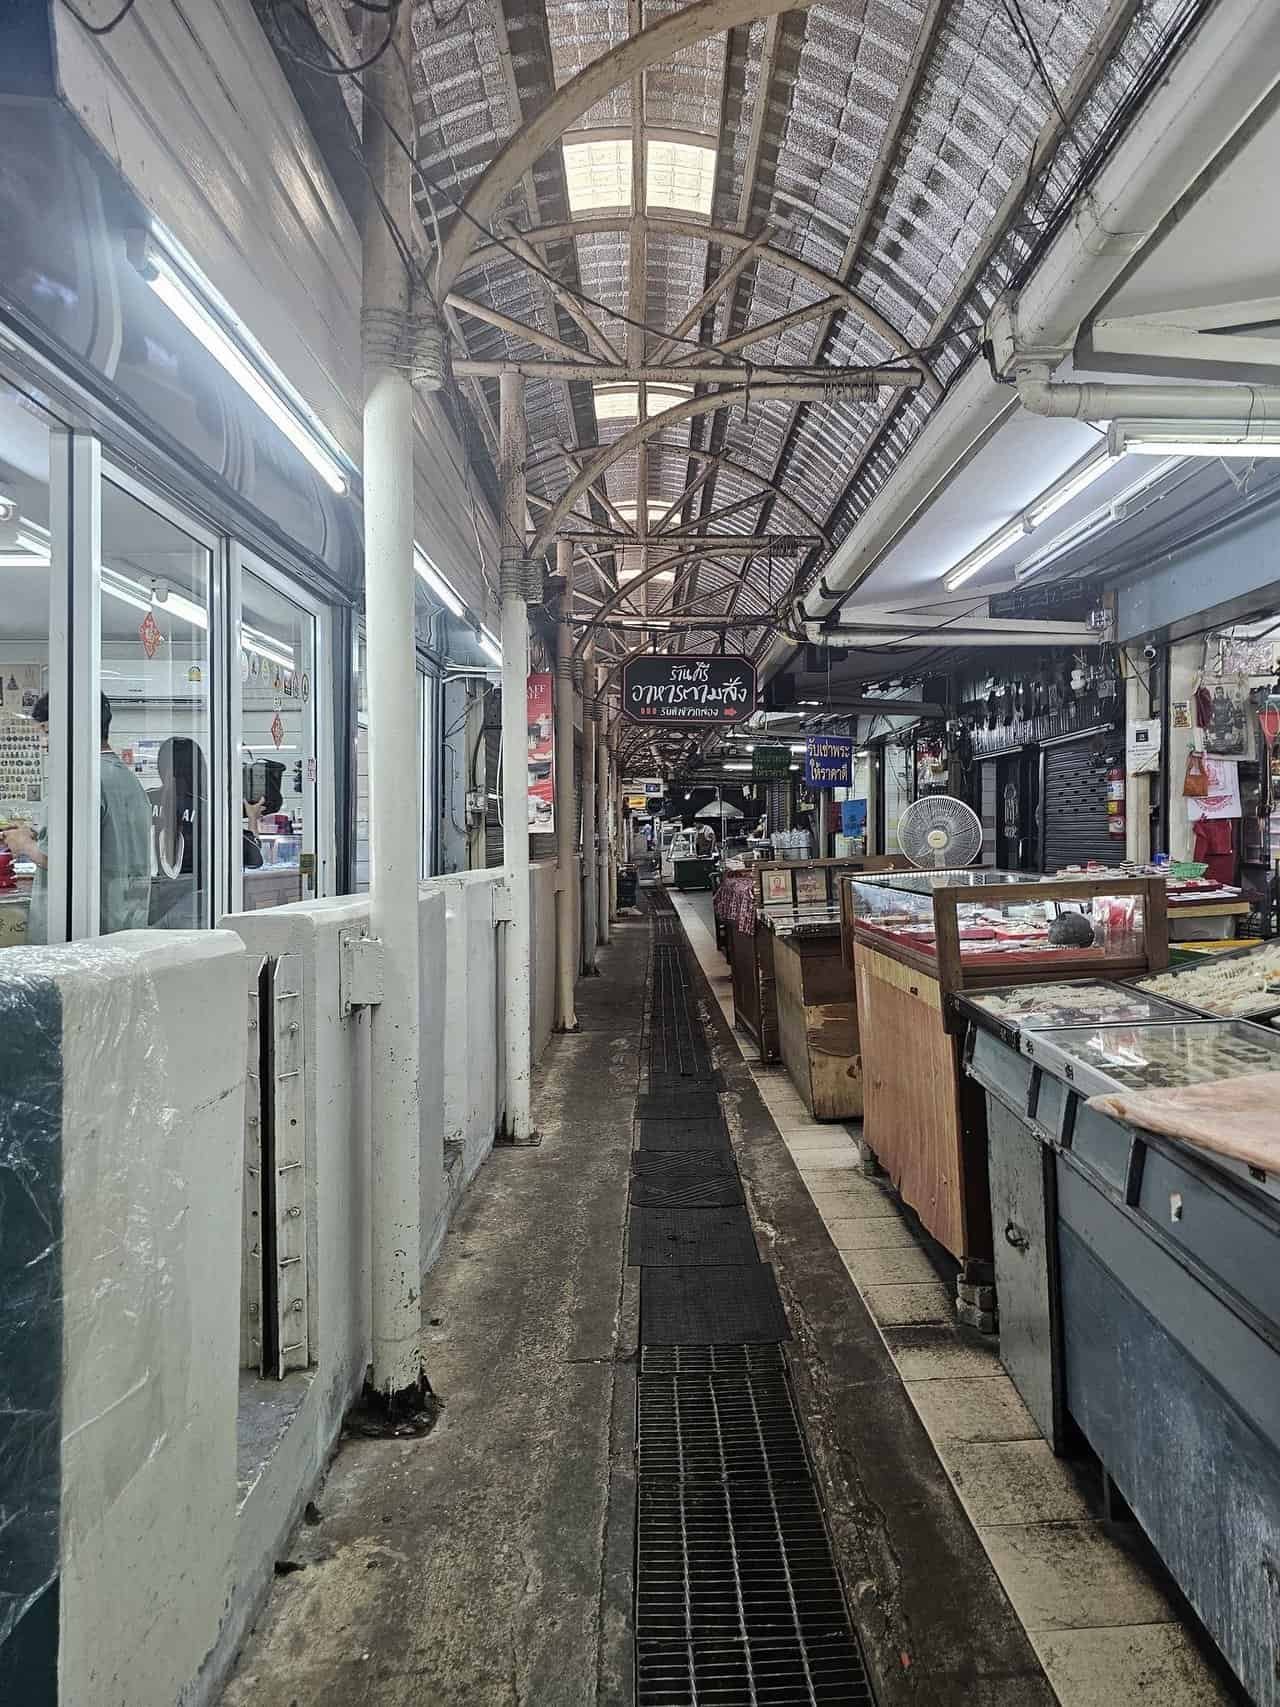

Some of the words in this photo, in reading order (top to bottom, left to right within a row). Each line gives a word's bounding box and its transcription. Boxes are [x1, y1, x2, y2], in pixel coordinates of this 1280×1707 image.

[631, 676, 748, 705] อาหารตามสั่ง
[808, 737, 850, 758] รับเช่าพระ
[809, 758, 848, 781] ให้ราคาดี
